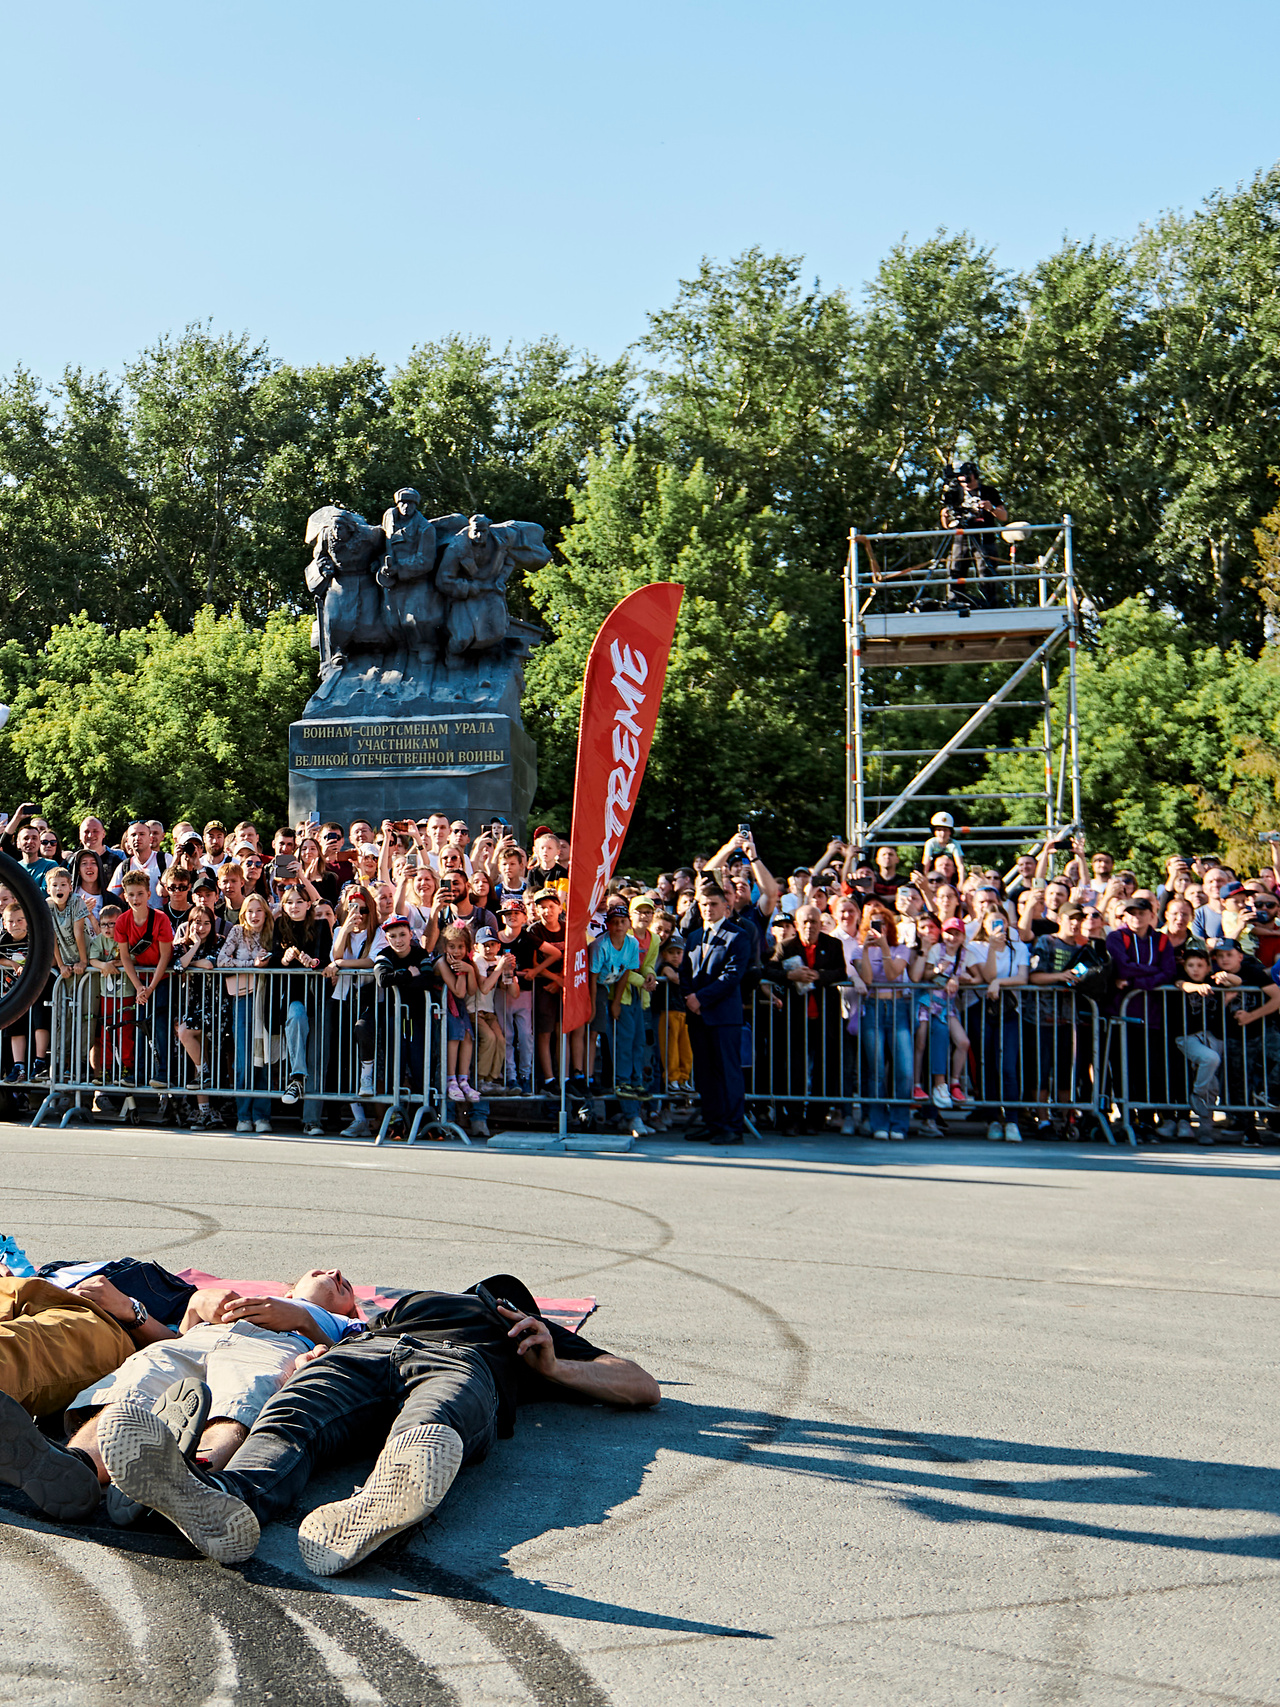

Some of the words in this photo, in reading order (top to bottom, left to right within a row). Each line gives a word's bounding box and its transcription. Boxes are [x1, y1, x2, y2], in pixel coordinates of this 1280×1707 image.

[455, 722, 495, 735] УРАЛА
[357, 738, 439, 751] УЧАСТНИКАМ
[295, 752, 349, 767] ВЕЛИКОЙ
[352, 750, 454, 765] ОТЕЧЕСТВЕННОЙ
[587, 637, 649, 917] EXTREME
